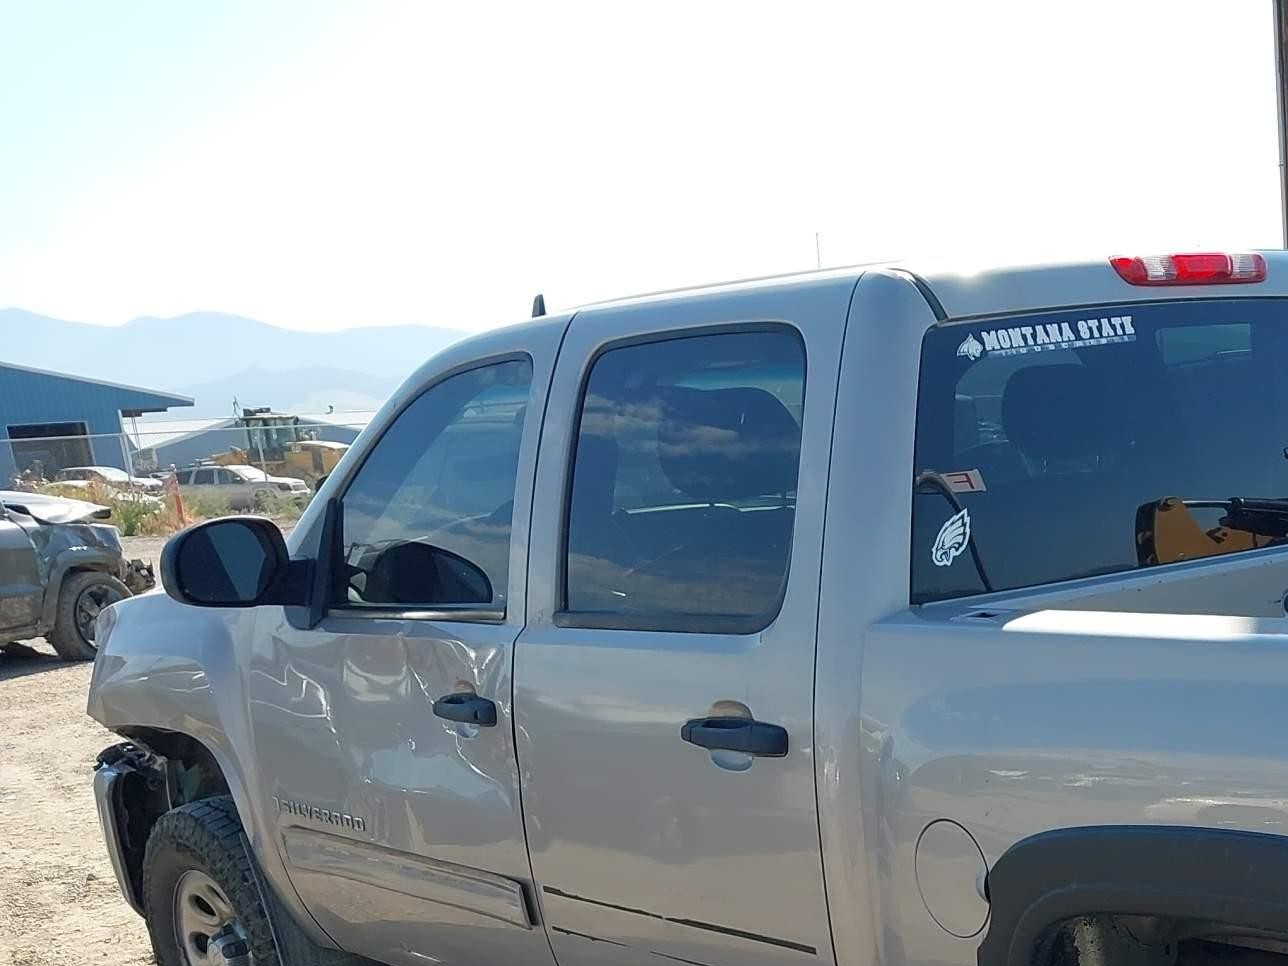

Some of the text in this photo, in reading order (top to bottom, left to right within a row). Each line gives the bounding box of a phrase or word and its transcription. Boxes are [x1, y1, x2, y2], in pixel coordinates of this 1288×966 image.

[980, 321, 1076, 351] MONTANA
[1077, 315, 1136, 340] STATE
[282, 799, 367, 832] SILVERADO
